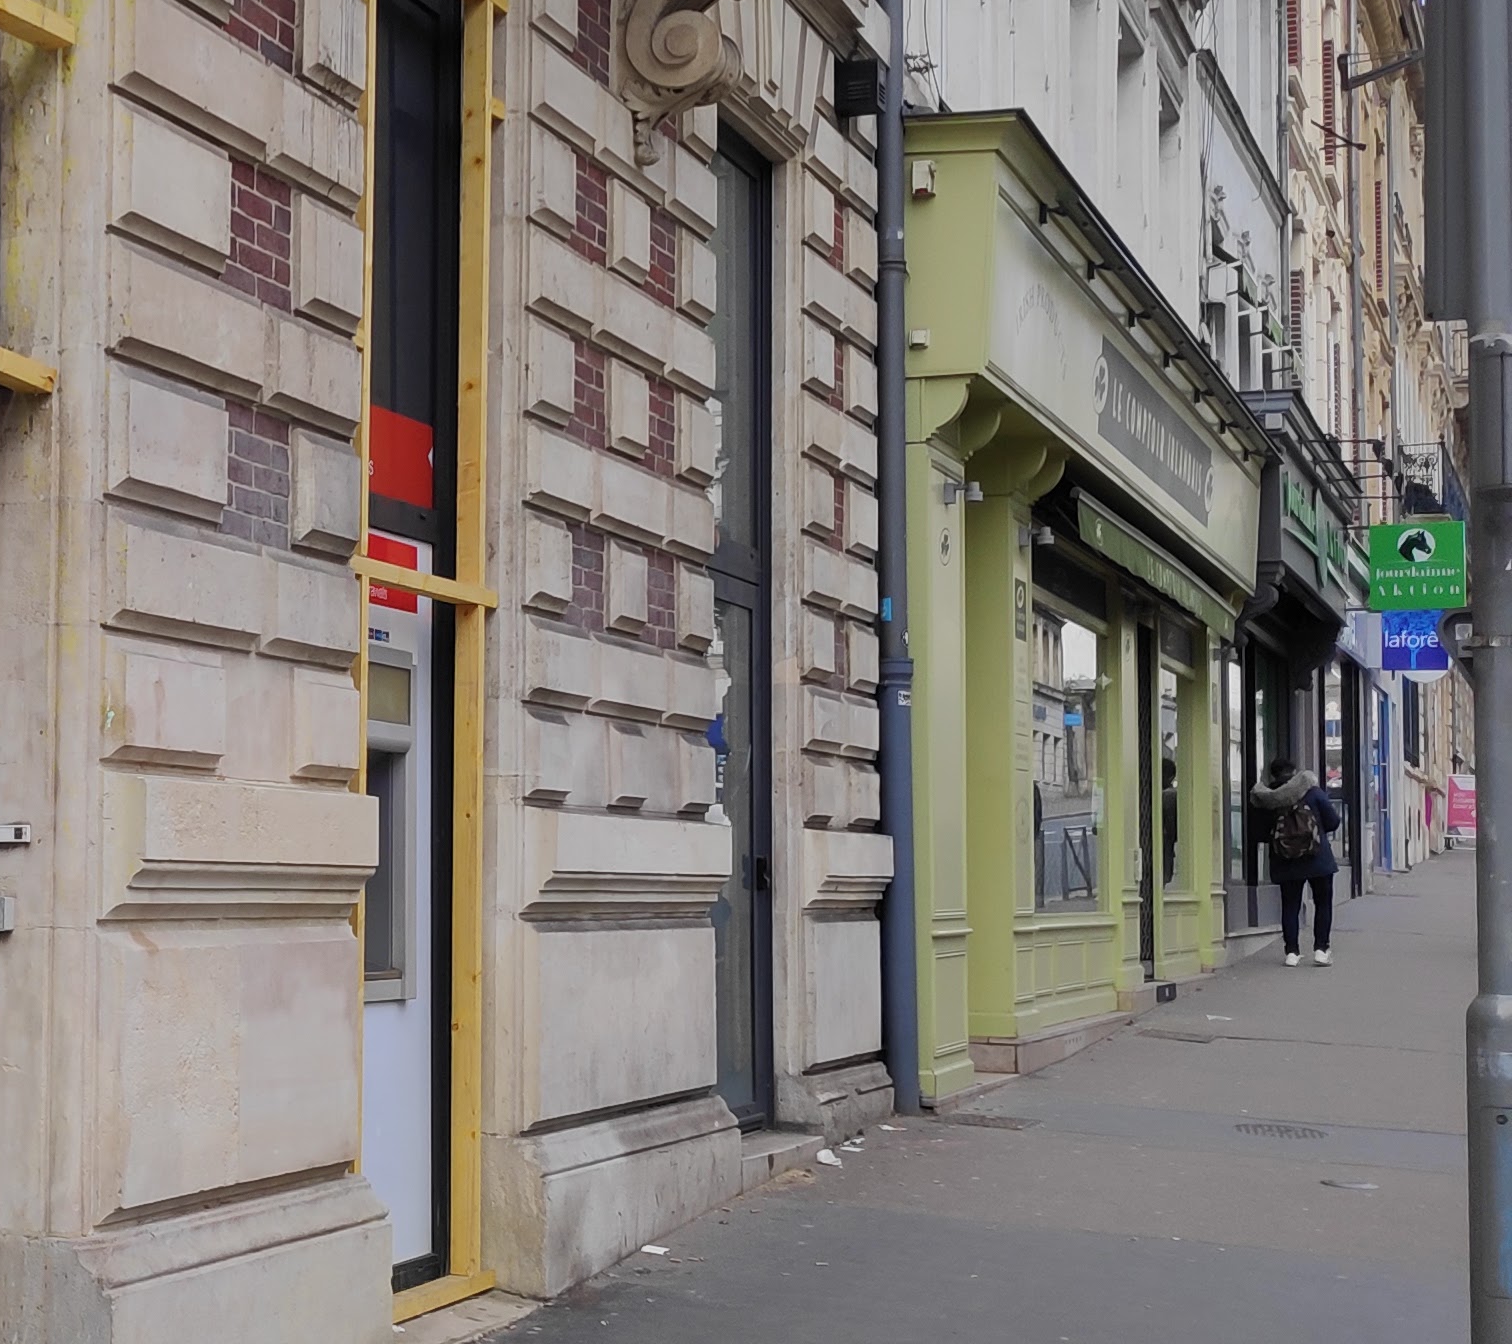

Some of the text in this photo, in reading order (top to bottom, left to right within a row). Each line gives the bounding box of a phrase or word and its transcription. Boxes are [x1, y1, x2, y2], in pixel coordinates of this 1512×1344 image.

[1112, 377, 1124, 423] LE
[1125, 391, 1166, 463] COMPTOIR
[1384, 629, 1443, 649] laforê
